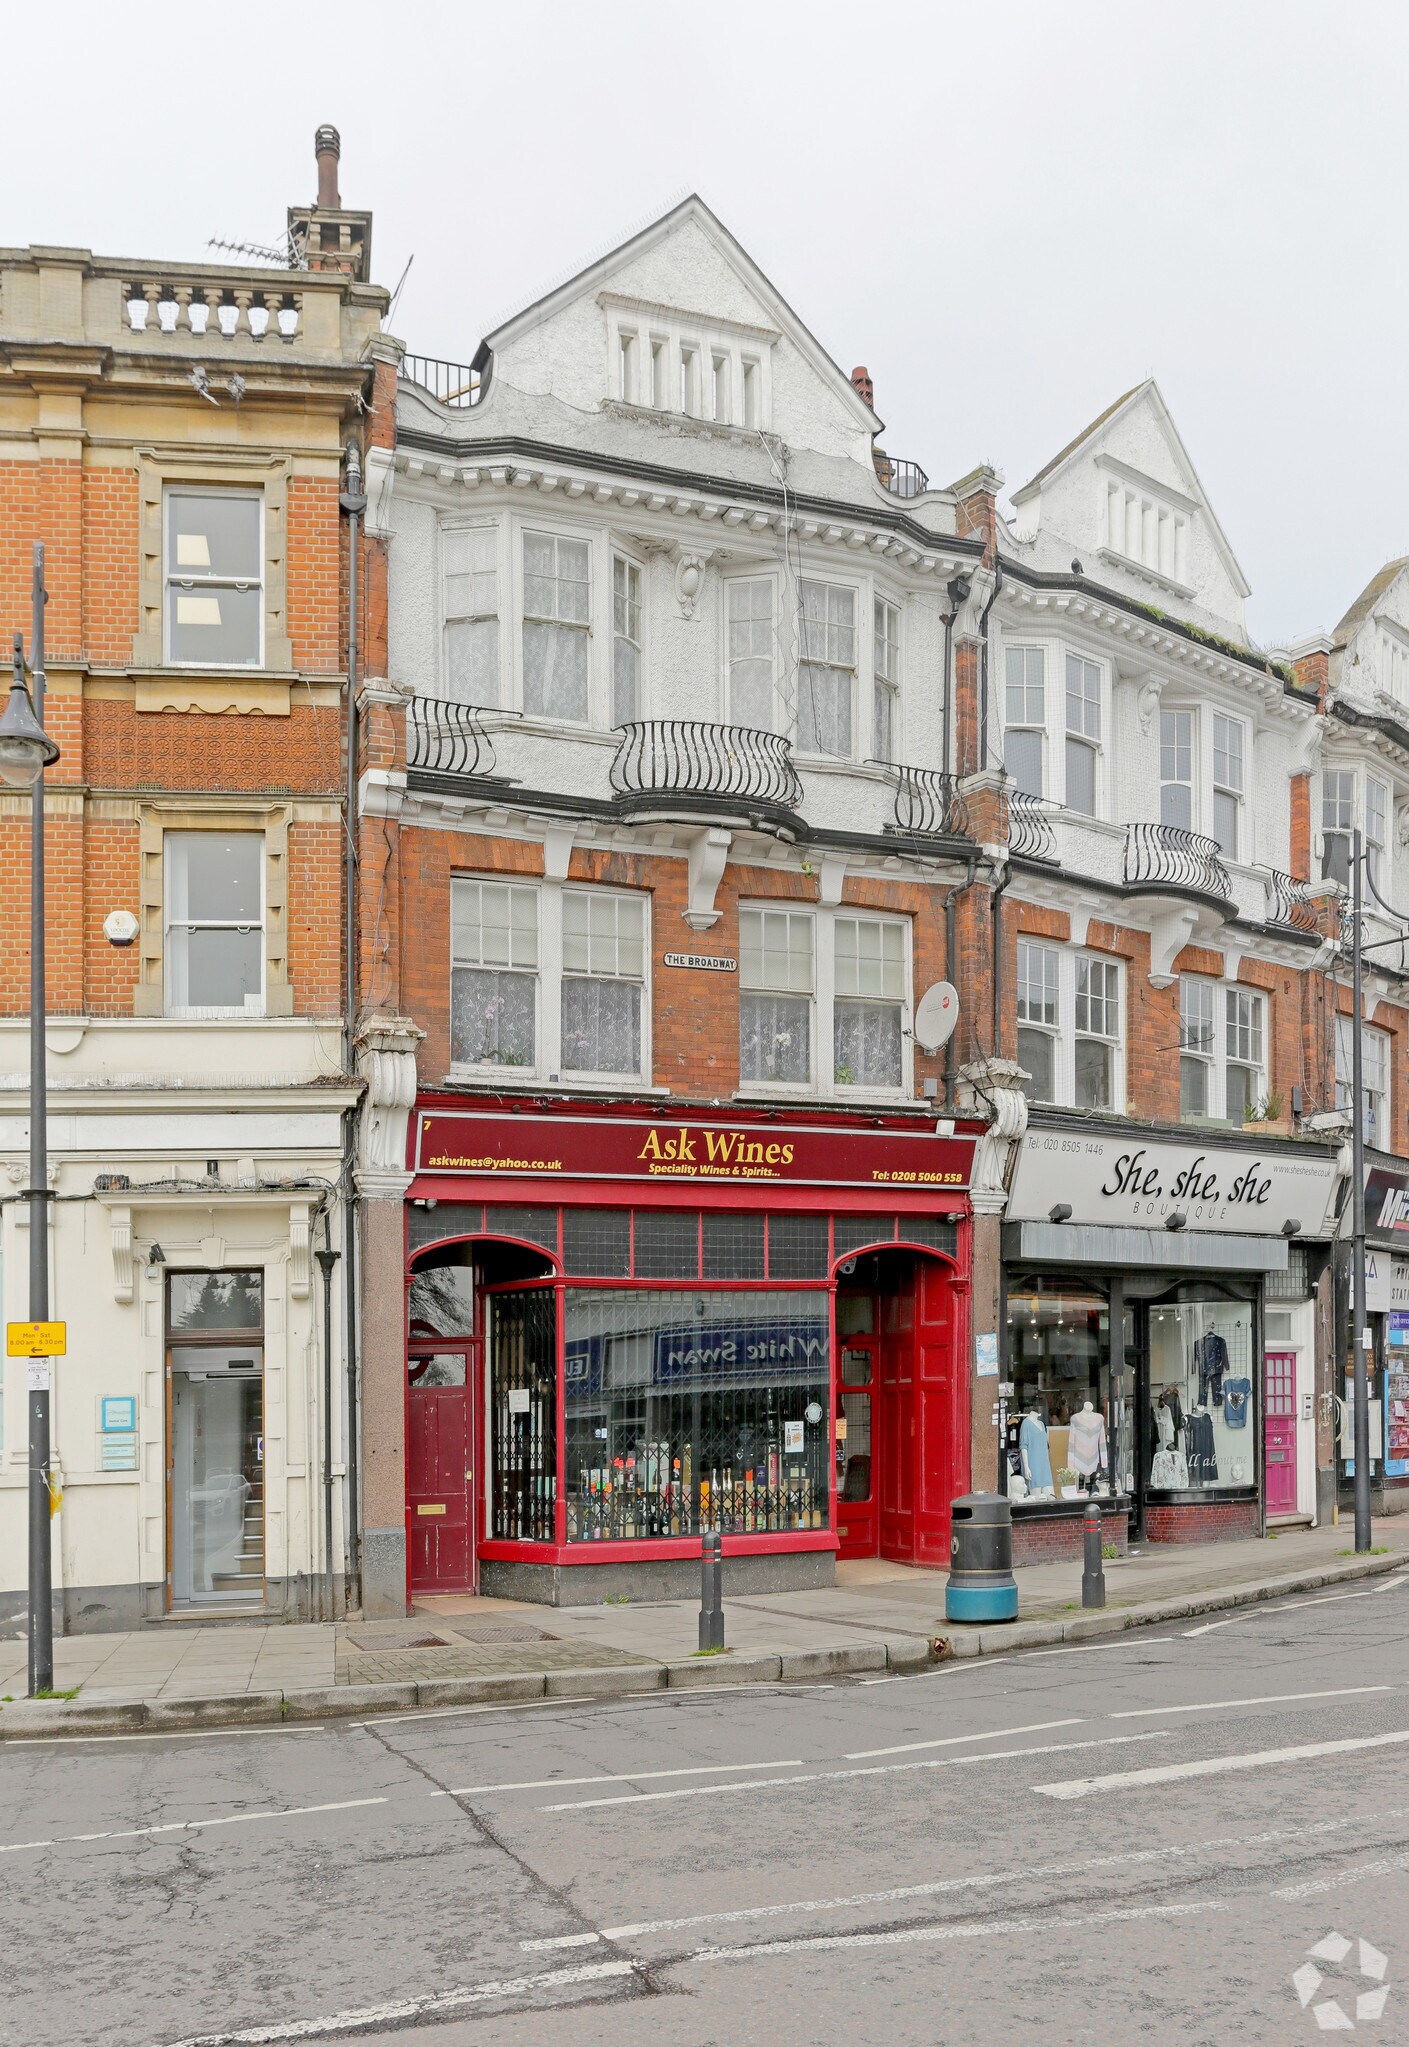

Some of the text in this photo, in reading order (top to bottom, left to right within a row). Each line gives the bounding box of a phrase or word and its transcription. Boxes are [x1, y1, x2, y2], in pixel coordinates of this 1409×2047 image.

[667, 955, 735, 969] THE BROADWAY
[424, 1121, 431, 1130] 7
[637, 1128, 794, 1164] Ask Wines
[1028, 1137, 1104, 1155] Tel: 020 8505 1446
[429, 1156, 562, 1169] askwines@yahoo.co.uk
[649, 1163, 781, 1177] Speciality Wines & Spirits...
[872, 1171, 962, 1182] Tel: 0208 5060 558
[1101, 1150, 1272, 1204] She, she, she
[1132, 1201, 1227, 1219] BOUTIQUE
